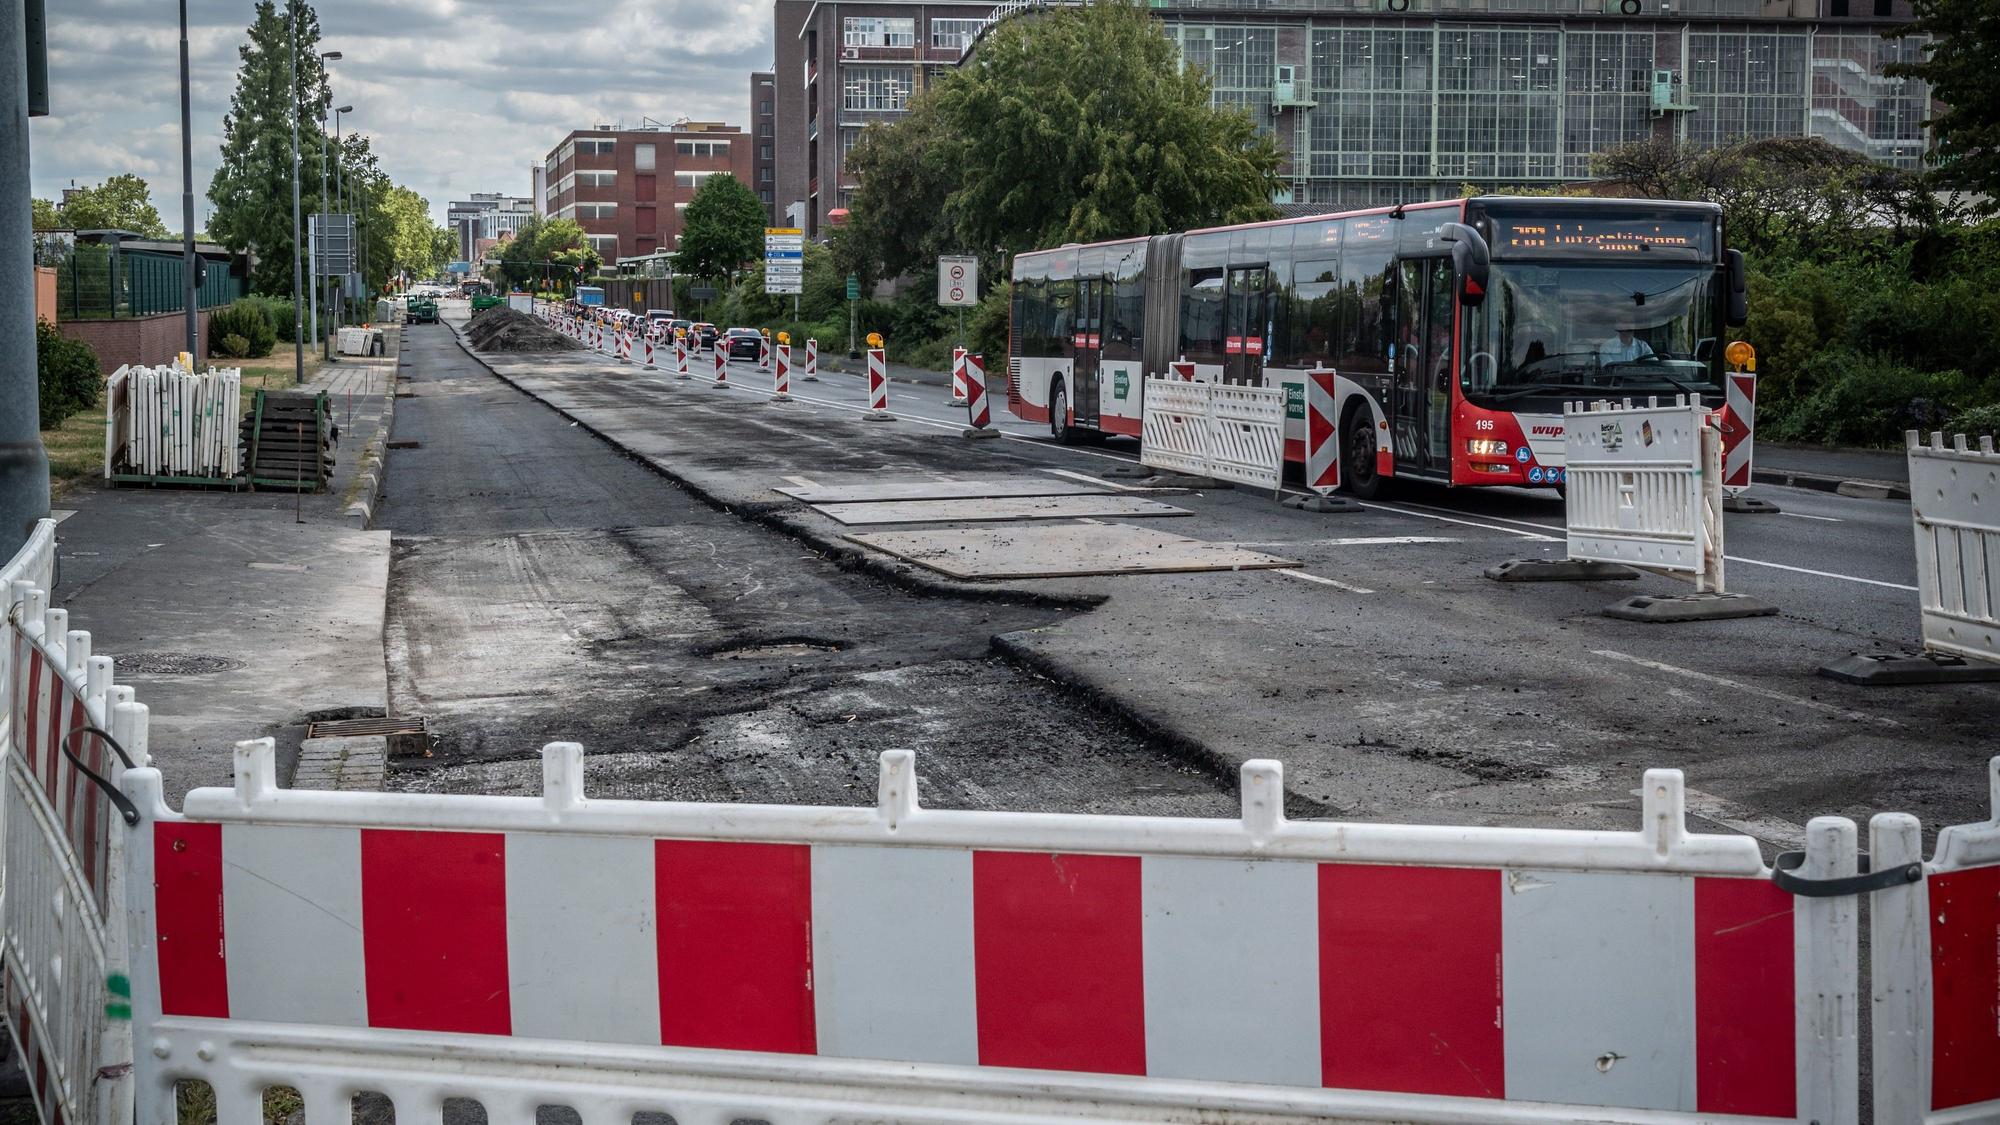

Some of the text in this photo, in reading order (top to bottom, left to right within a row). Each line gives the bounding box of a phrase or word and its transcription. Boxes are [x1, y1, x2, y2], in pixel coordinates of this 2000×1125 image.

[1288, 403, 1303, 413] vorne
[1476, 419, 1494, 431] 195
[1532, 426, 1565, 438] wup
